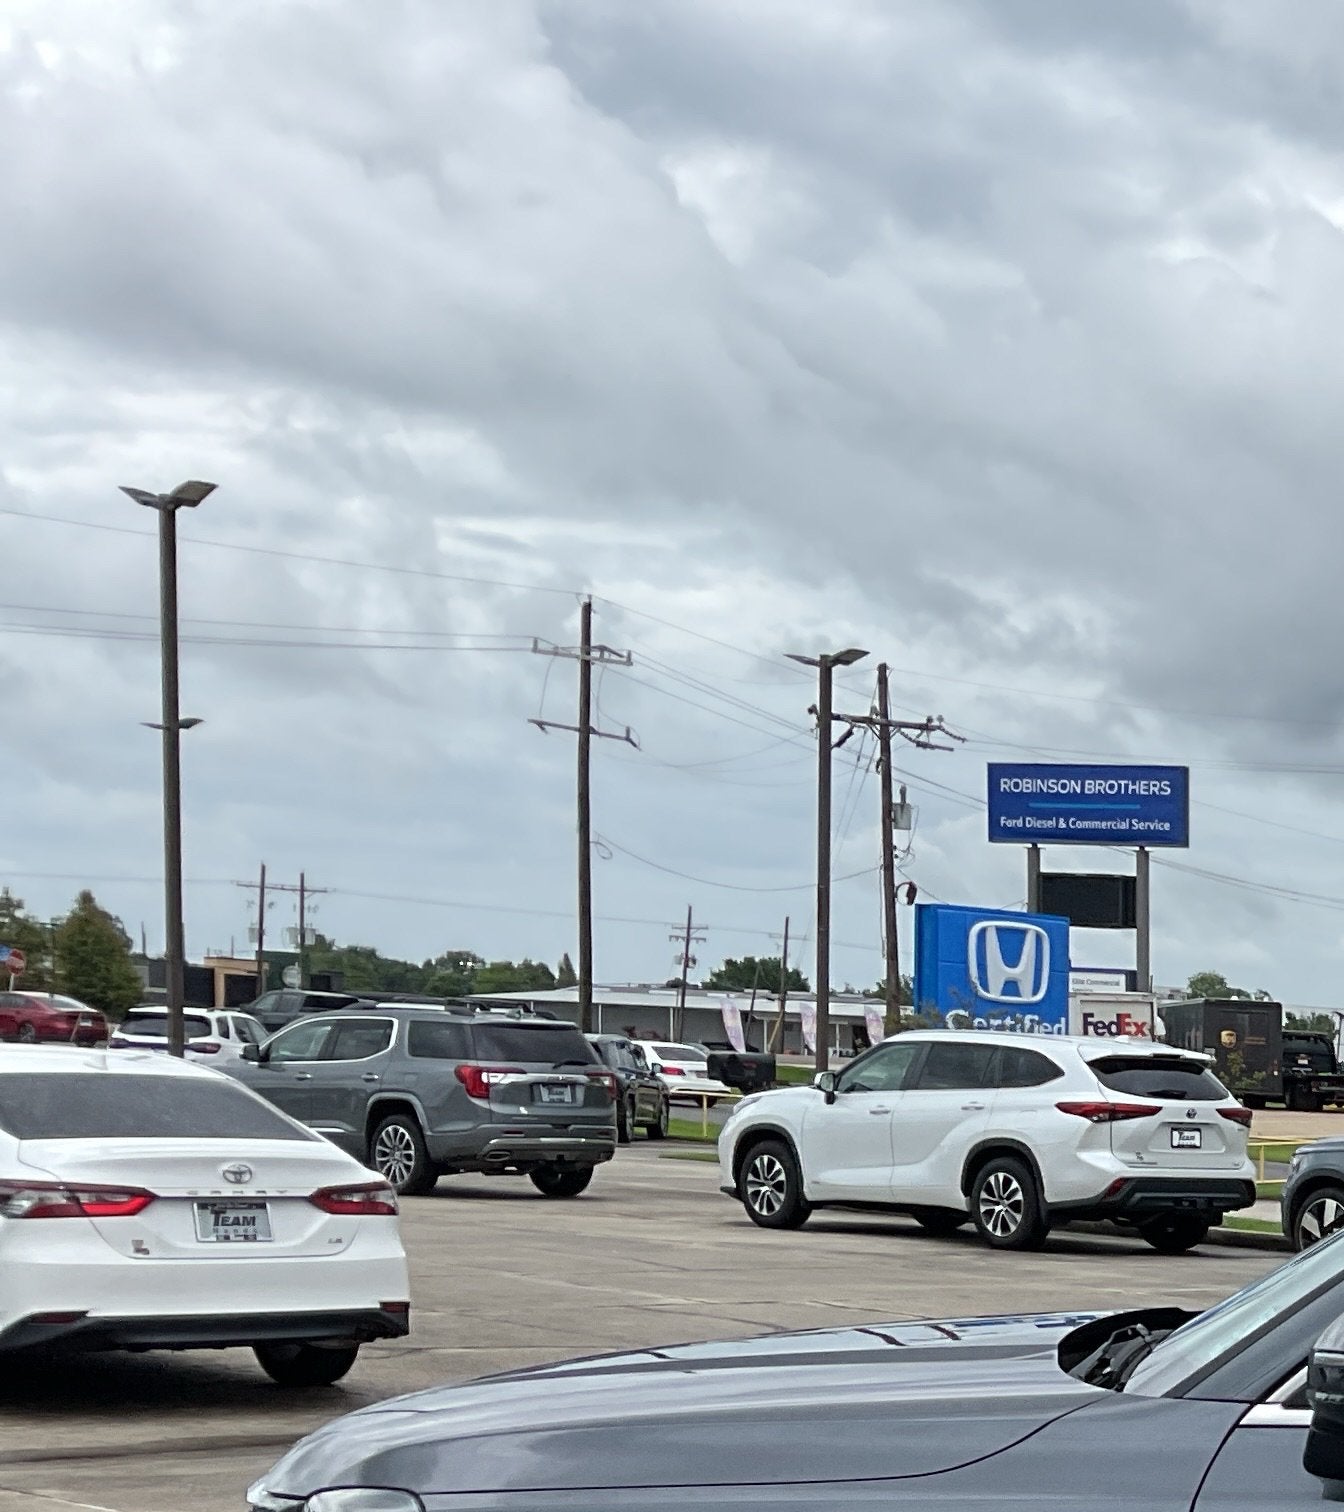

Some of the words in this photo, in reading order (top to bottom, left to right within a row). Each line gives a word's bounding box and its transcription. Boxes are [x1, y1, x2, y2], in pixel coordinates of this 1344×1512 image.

[999, 778, 1081, 794] ROBINSON
[1084, 779, 1172, 796] BROTHERS
[1000, 817, 1023, 828] Ford
[1025, 817, 1056, 829] Diesel
[1058, 818, 1067, 828] &
[1069, 817, 1129, 830] Commercial
[1132, 818, 1171, 831] Service
[1082, 1013, 1147, 1037] FedEx
